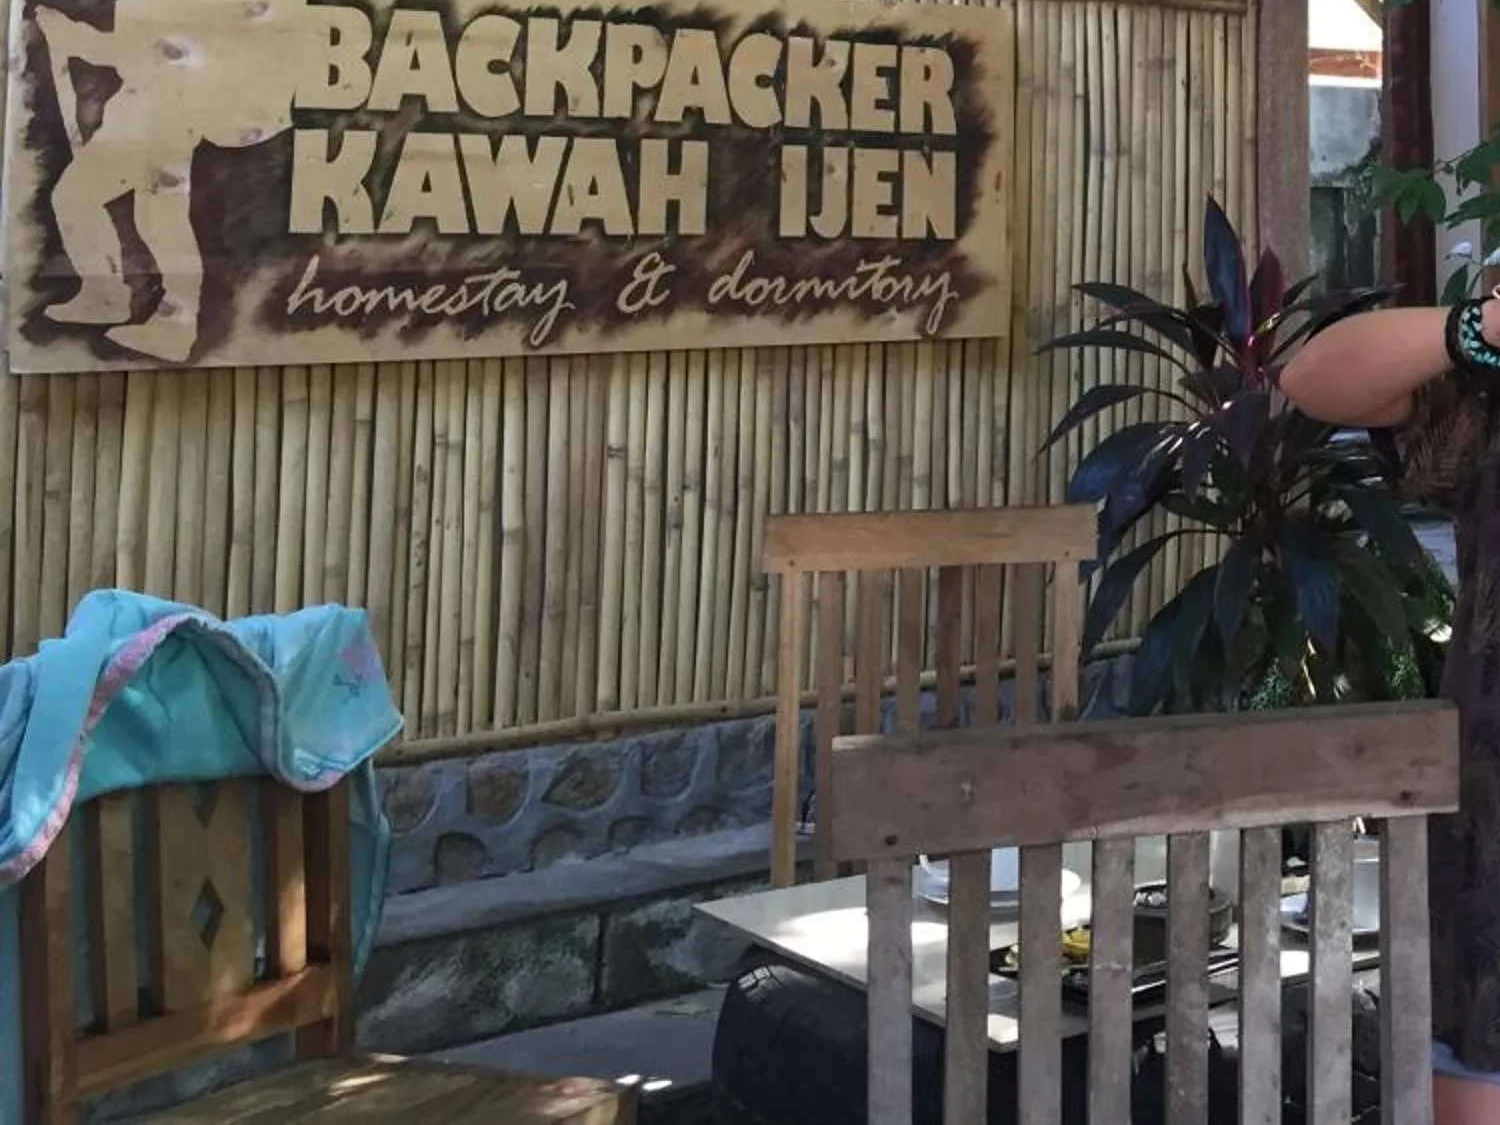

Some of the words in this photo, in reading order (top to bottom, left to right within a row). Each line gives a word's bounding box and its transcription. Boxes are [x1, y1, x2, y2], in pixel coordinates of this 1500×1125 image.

[294, 4, 956, 135] BACKPACKER
[288, 129, 709, 235] KAWAH
[779, 144, 956, 239] IJEN
[287, 254, 575, 346] homestay
[616, 251, 676, 313] &
[707, 249, 959, 334] dormitory
